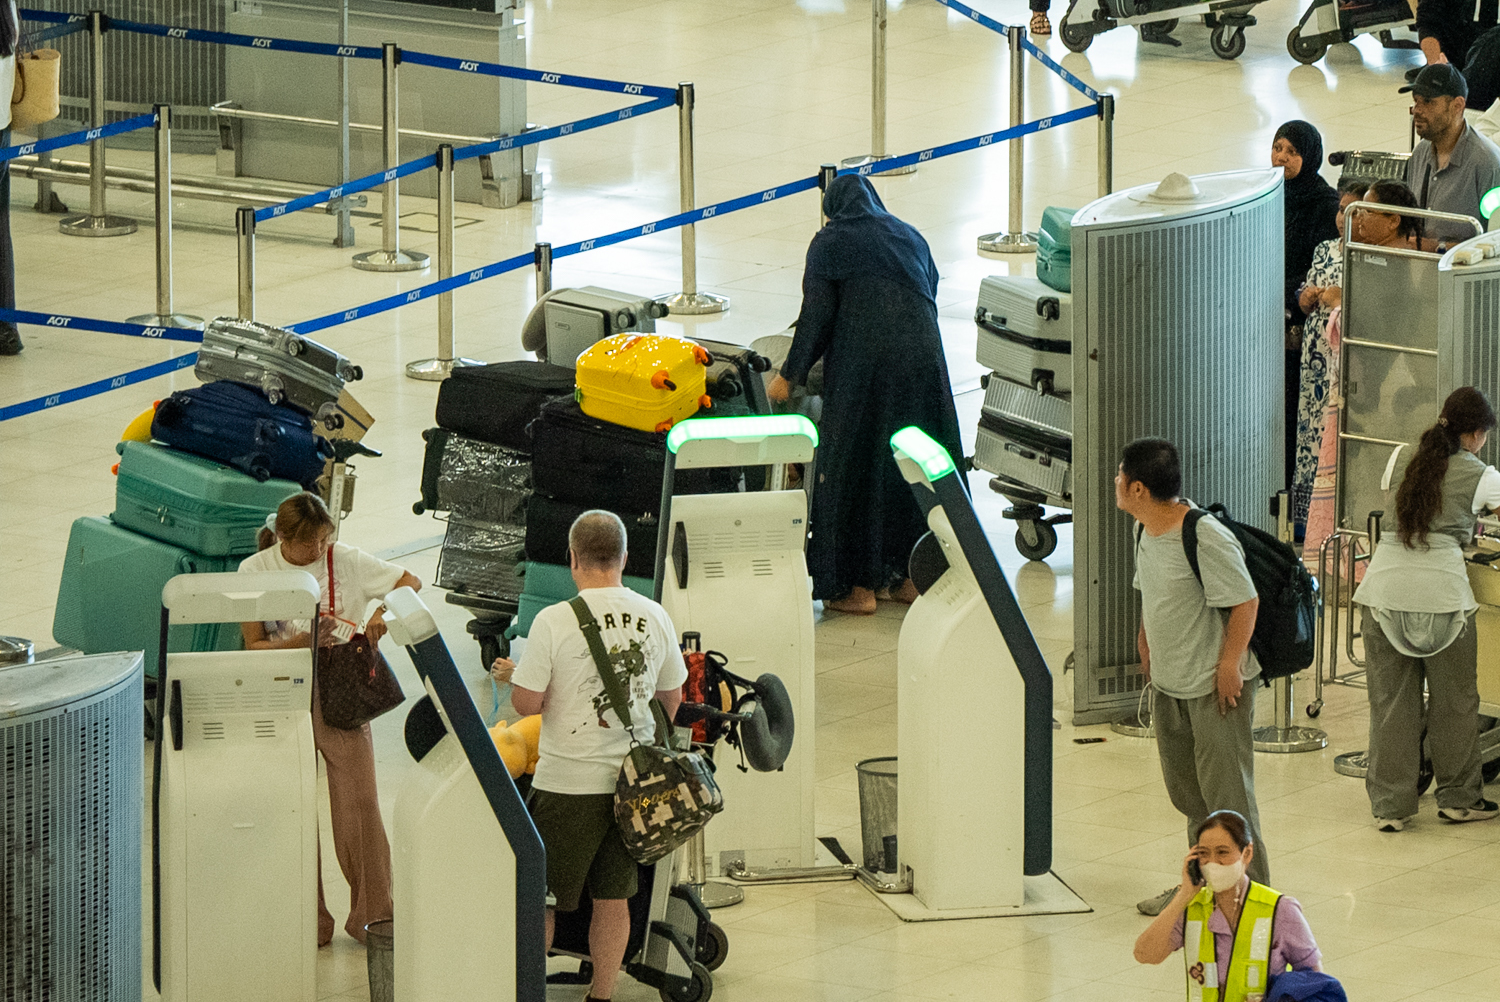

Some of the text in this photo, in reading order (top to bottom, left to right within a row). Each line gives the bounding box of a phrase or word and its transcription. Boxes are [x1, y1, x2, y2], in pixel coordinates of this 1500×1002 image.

[167, 28, 188, 39] AOT
[252, 38, 272, 48] AOT
[541, 73, 561, 84] AOT
[623, 84, 644, 95] AOT
[559, 124, 574, 136] AOT
[1038, 118, 1053, 130] AOT
[86, 129, 102, 141] AOT
[978, 135, 994, 147] AOT
[18, 144, 36, 156] AOT
[702, 206, 717, 218] AOT
[579, 240, 595, 251] AOT
[469, 269, 484, 281] AOT
[47, 316, 71, 327] AOT
[141, 327, 166, 338] AOT
[110, 376, 127, 388] AOT
[598, 613, 648, 634] APE
